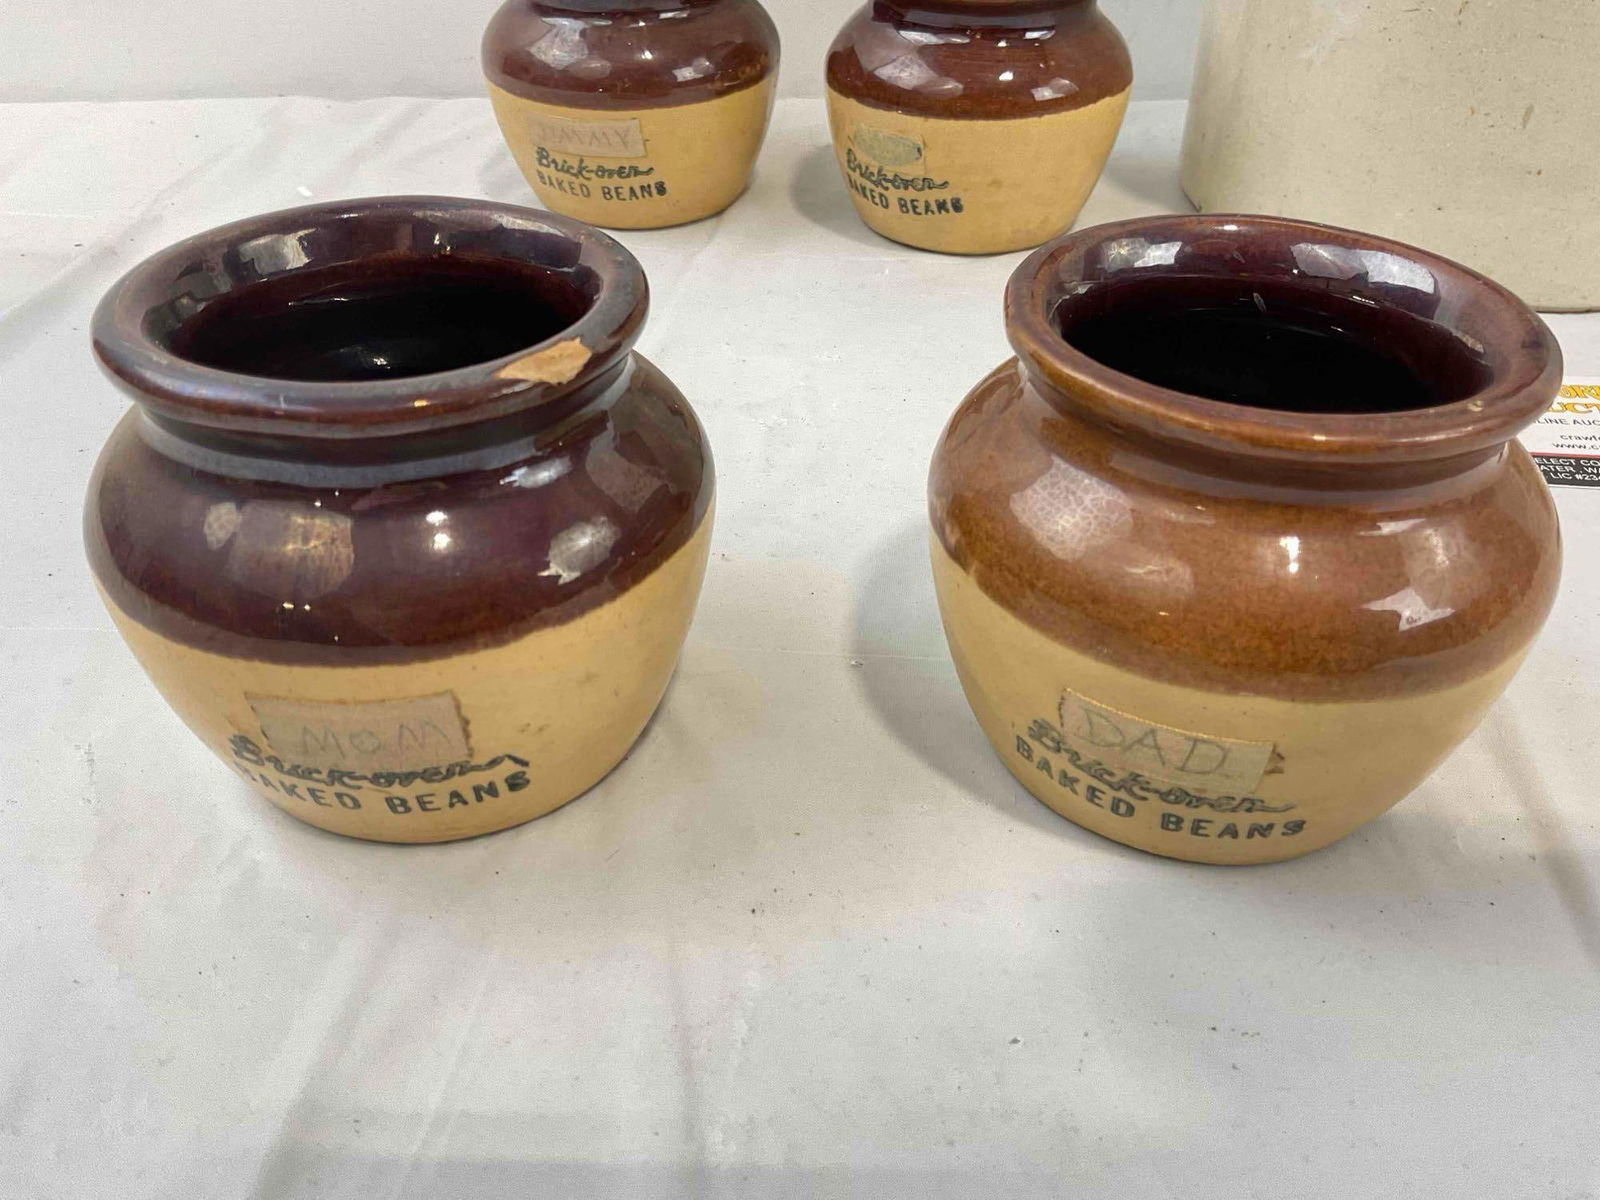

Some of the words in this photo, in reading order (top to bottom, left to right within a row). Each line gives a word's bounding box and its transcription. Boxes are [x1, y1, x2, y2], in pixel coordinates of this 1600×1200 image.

[1075, 705, 1230, 774] DAD
[384, 771, 531, 814] BEANS
[1016, 735, 1136, 818] BAKED
[1160, 812, 1307, 840] BEANS
